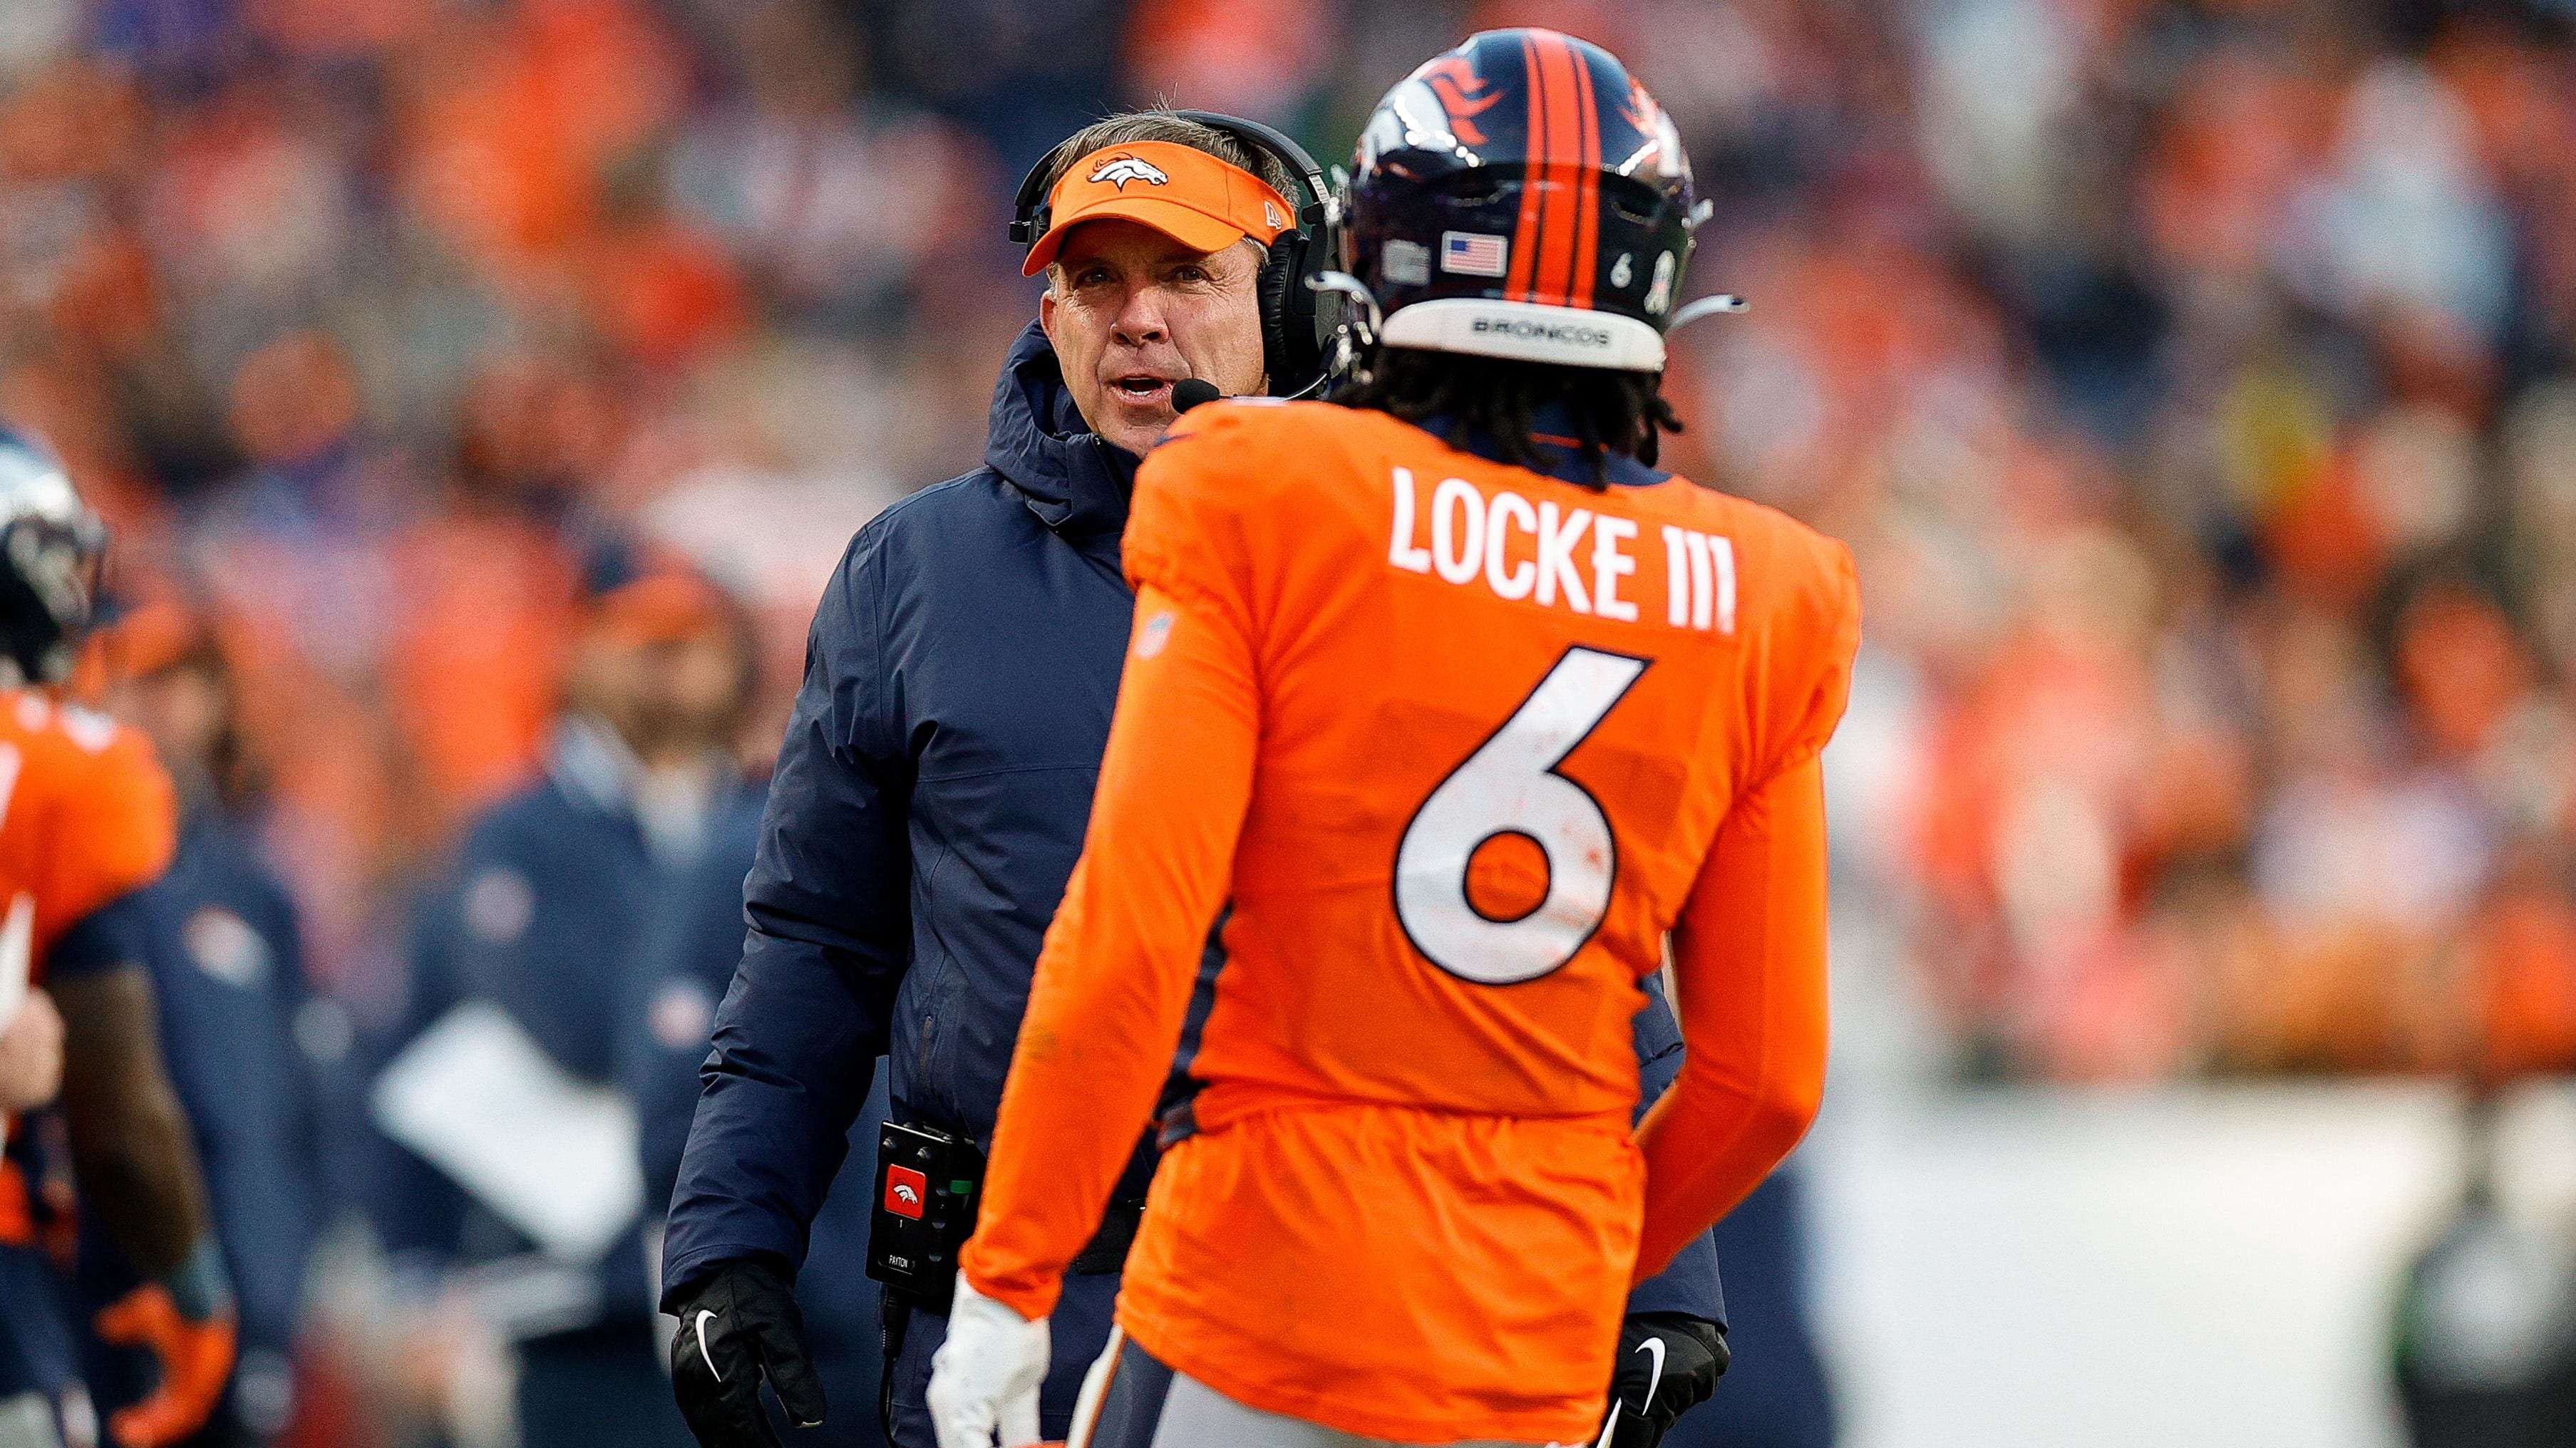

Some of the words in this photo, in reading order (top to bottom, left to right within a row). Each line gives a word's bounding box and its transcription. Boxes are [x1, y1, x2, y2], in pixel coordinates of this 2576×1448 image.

[1610, 252, 1632, 289] 6
[1473, 319, 1611, 346] BRONCOS
[1389, 466, 1639, 623] LOCKE
[1661, 524, 1737, 635] III
[1394, 643, 1655, 986] 6
[889, 1254, 908, 1268] PAYTON
